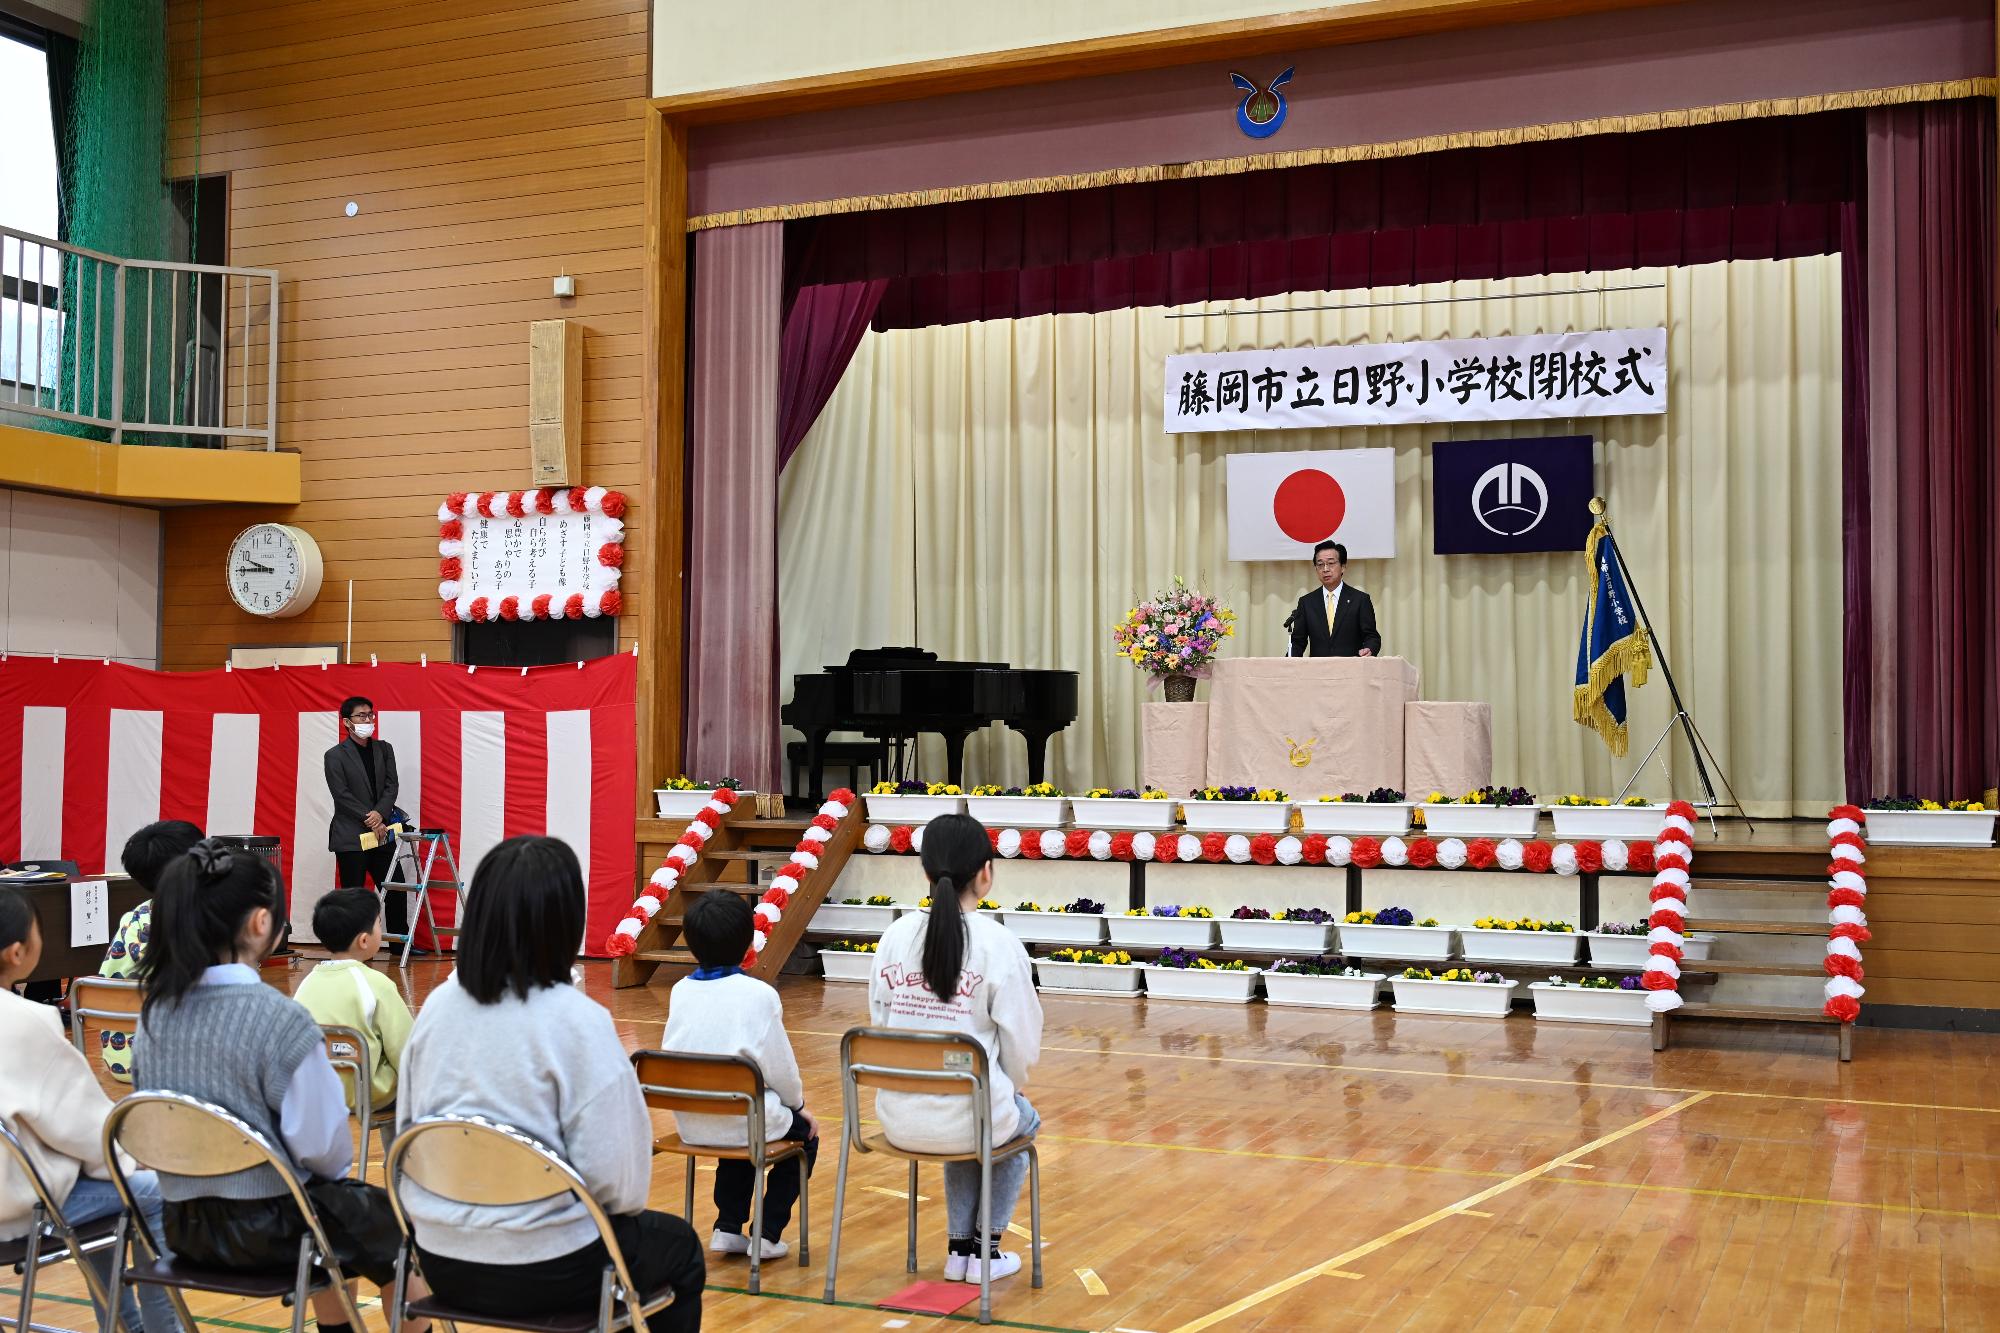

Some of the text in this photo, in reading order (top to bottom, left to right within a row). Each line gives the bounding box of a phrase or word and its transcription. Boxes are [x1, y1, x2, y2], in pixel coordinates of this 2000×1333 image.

[1177, 347, 1655, 417] 藤岡市立日野小学校閉校式
[264, 533, 272, 545] 12
[480, 519, 489, 549] 健康で
[513, 519, 523, 558] 心豊かで
[538, 517, 547, 558] 自ら学び
[252, 537, 259, 550] 11
[242, 551, 250, 562] 10
[286, 547, 293, 558] 2
[503, 529, 513, 579] 思いやりの
[528, 528, 538, 589] 自ら考える子
[471, 530, 479, 591] たくましい子
[288, 563, 295, 574] 3
[494, 560, 503, 590] ある子
[243, 582, 249, 593] 8
[285, 580, 291, 591] 4
[253, 592, 259, 604] 7
[264, 596, 270, 607] 6
[276, 592, 282, 602] 5
